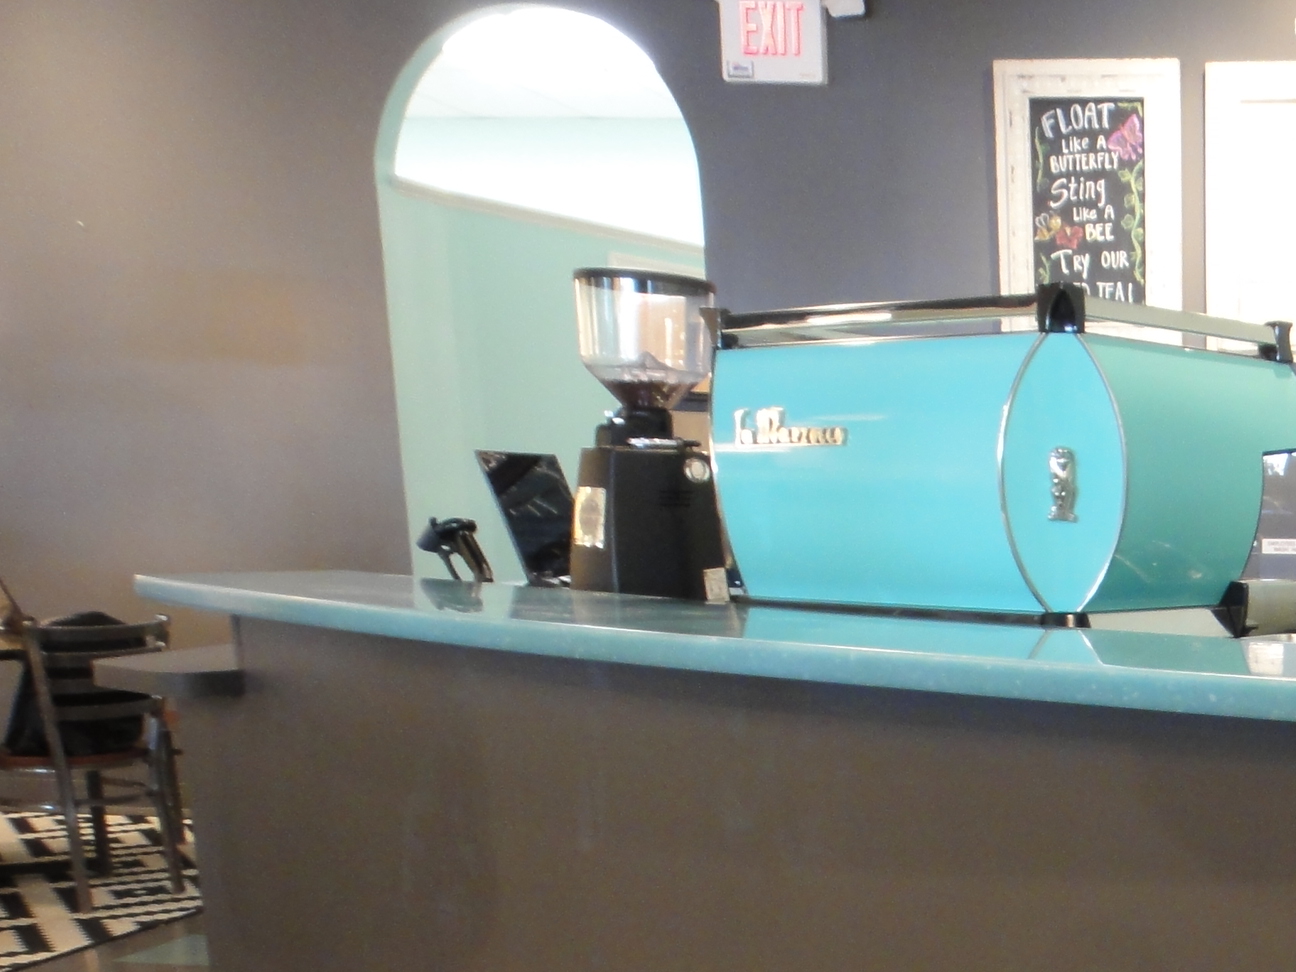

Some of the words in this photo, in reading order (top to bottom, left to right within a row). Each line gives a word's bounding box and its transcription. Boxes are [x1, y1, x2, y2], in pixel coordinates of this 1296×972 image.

[739, 0, 804, 56] EXIT
[1041, 102, 1115, 138] FLOAT
[1096, 134, 1107, 151] A
[1049, 153, 1119, 173] BUTTERFLY
[1050, 177, 1106, 207] Sting
[1104, 204, 1115, 220] A
[1084, 223, 1115, 242] BEE
[1101, 251, 1130, 269] OUR
